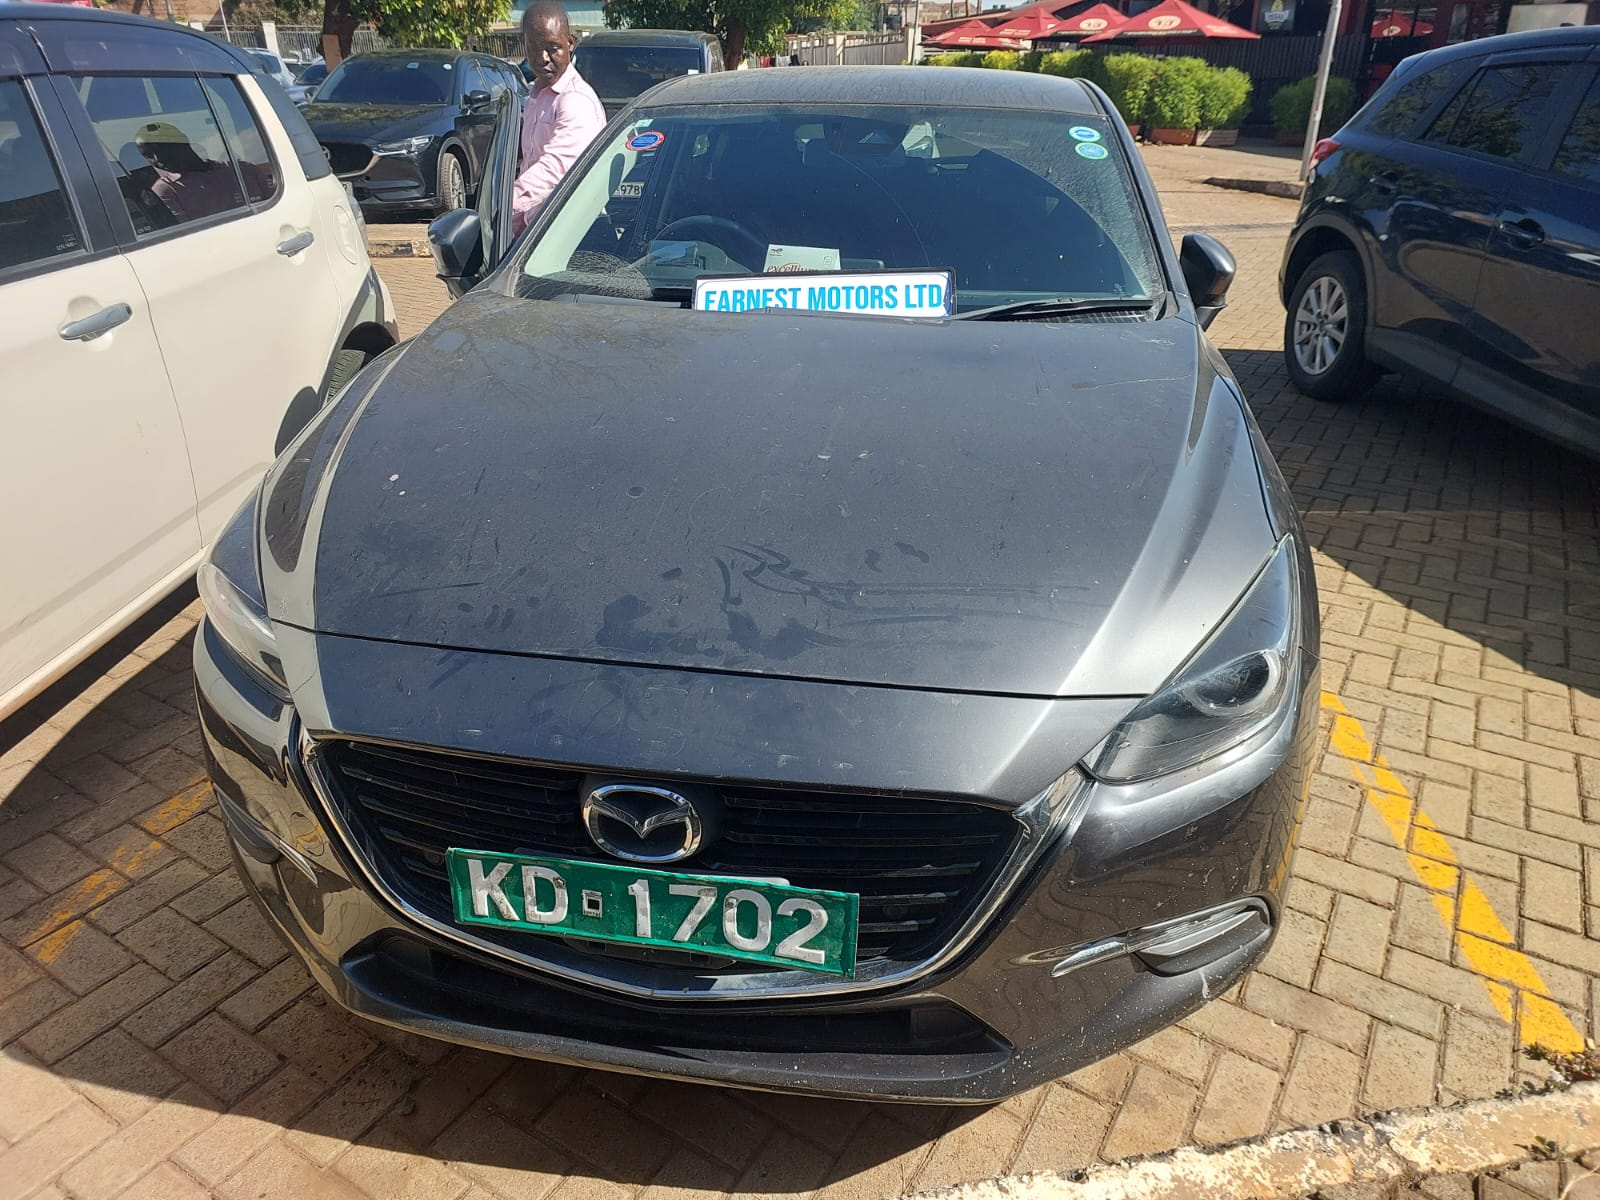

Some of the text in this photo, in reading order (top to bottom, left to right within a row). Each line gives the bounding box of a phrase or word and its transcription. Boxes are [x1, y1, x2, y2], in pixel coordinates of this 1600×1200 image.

[704, 284, 942, 313] EARNEST MOTORS LTD
[467, 858, 829, 965] KD 1702
